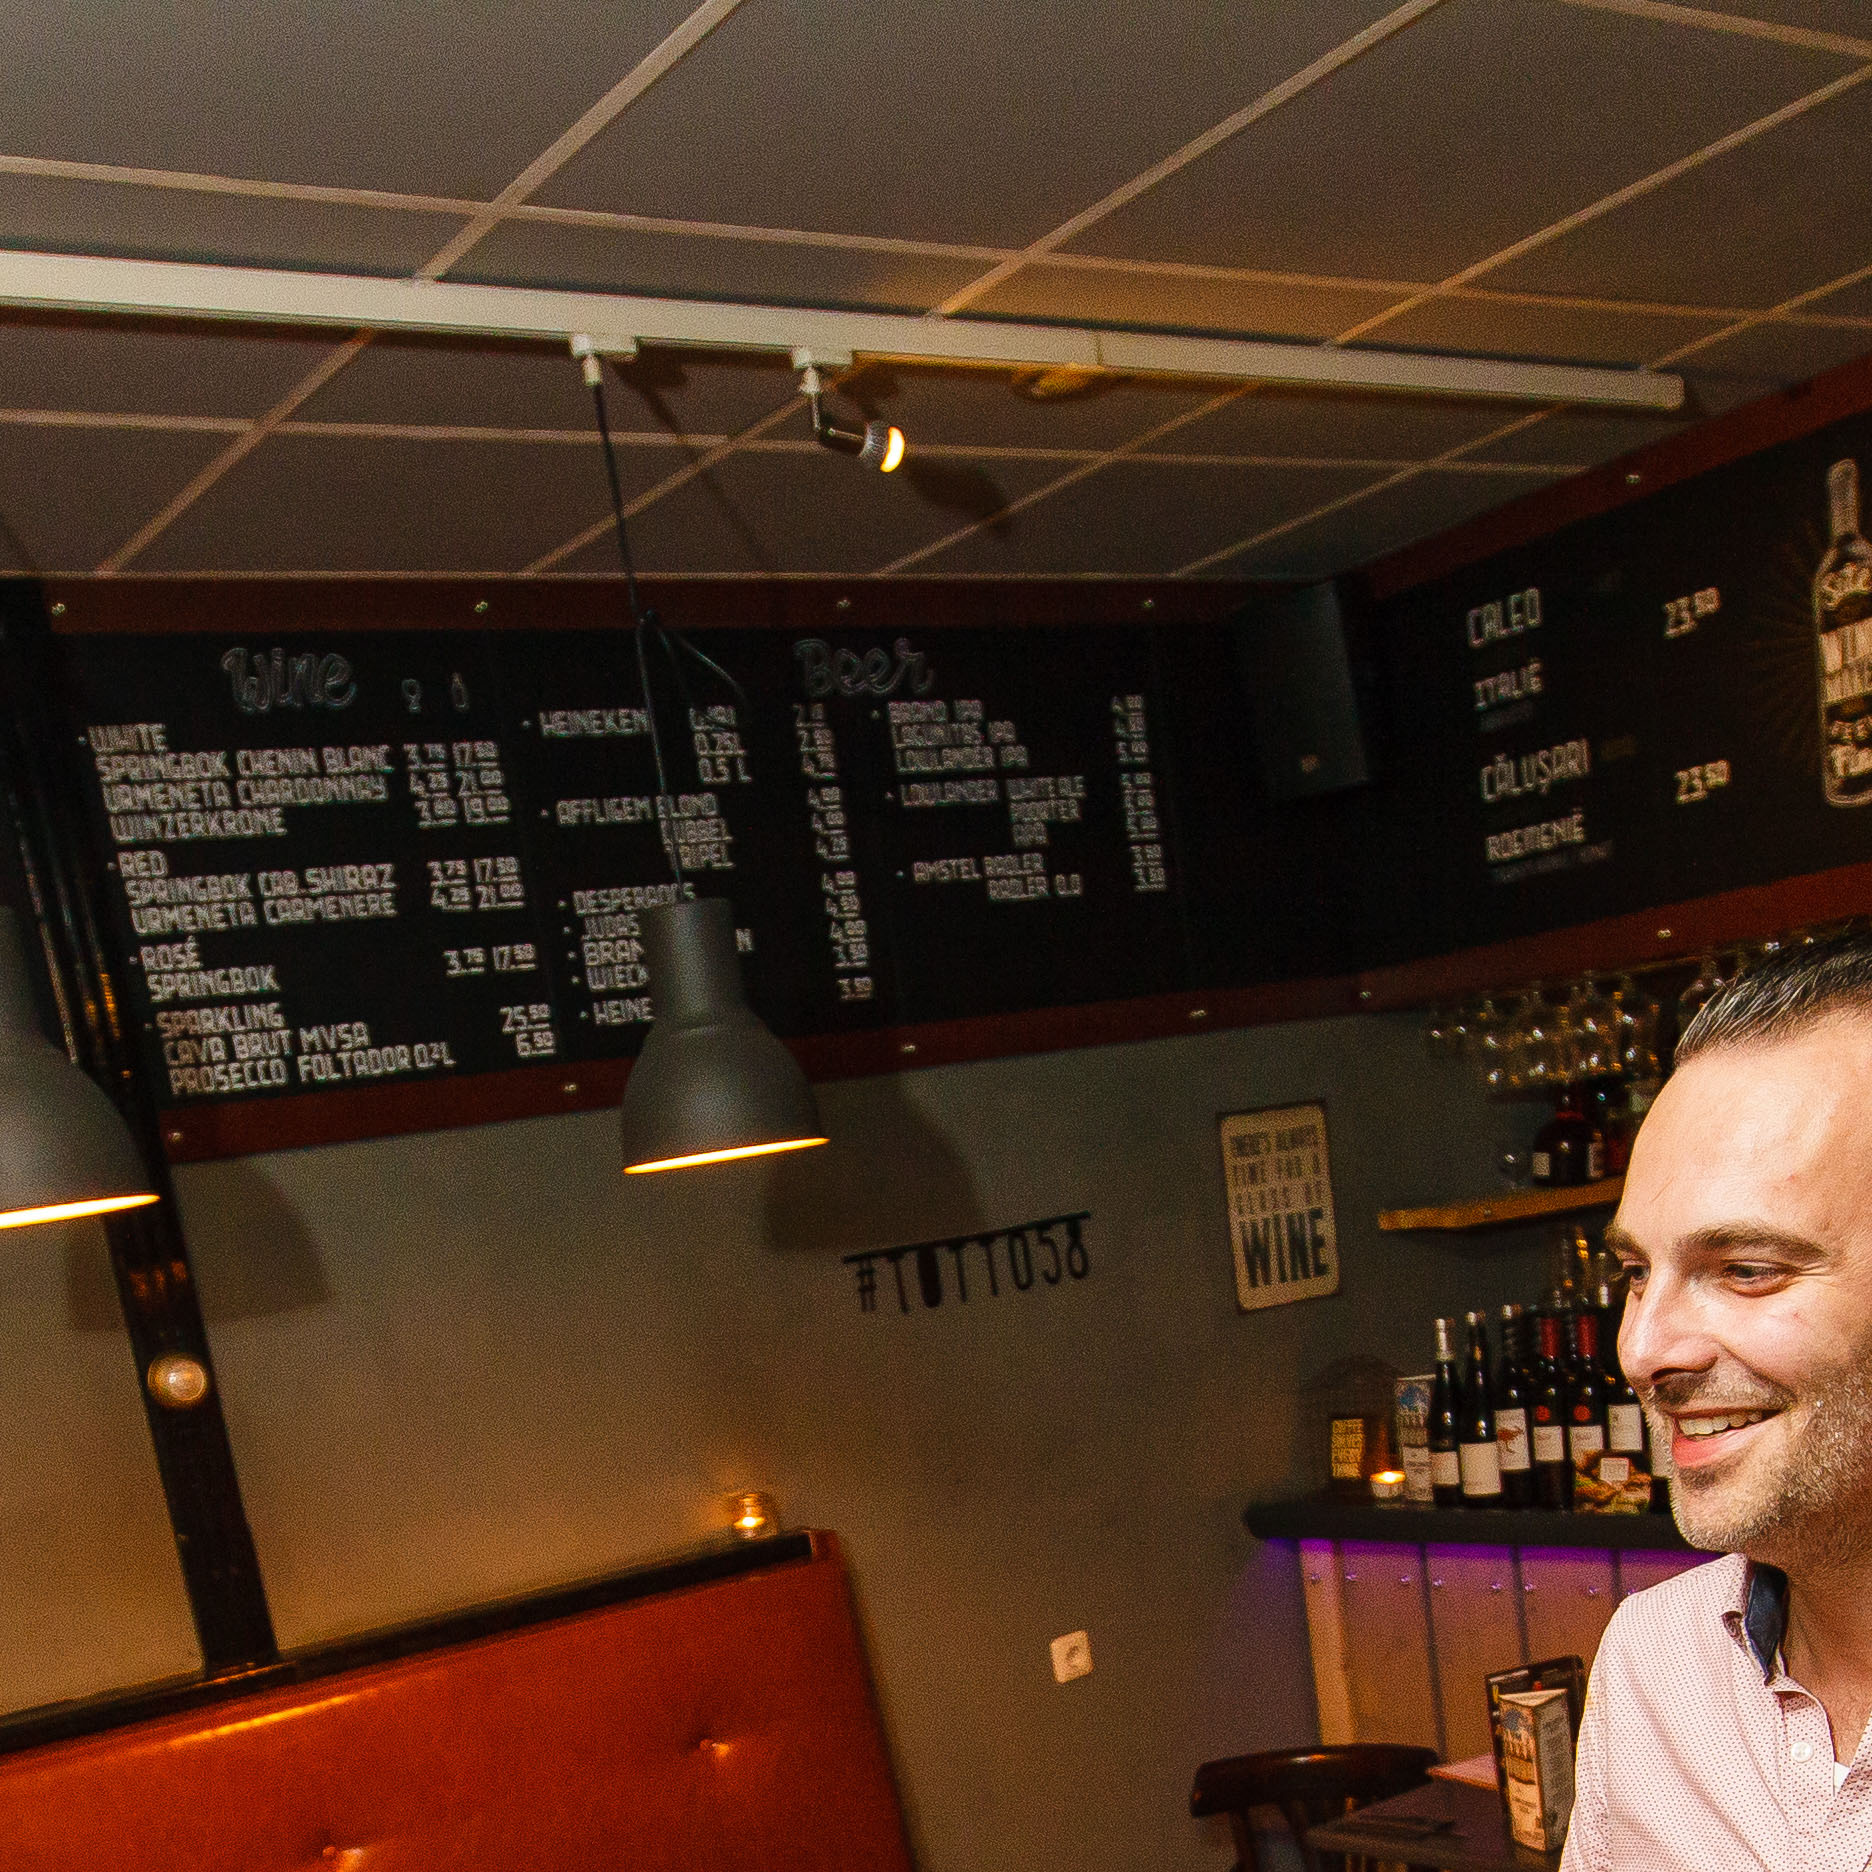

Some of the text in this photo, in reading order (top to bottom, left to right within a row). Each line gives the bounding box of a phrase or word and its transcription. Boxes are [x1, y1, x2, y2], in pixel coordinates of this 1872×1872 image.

[220, 646, 358, 713] Wine
[792, 637, 934, 696] Beer
[539, 707, 651, 738] HEINEKEN
[94, 750, 232, 783] SPRINGBOK
[235, 746, 320, 778] CHENIN
[555, 796, 654, 826] AFFLIGEM
[117, 849, 168, 878] RED
[124, 872, 253, 907] SPRINGBOK
[139, 934, 204, 972] ROSÉ
[146, 964, 282, 1002] SPRINGBOK
[155, 1001, 286, 1039] SPARKLING
[163, 1036, 228, 1067] CAVA
[231, 1028, 294, 1060] BRUT
[298, 1021, 371, 1053] MVSA
[168, 1057, 289, 1097] PROSECCO
[1238, 1207, 1329, 1289] WINE
